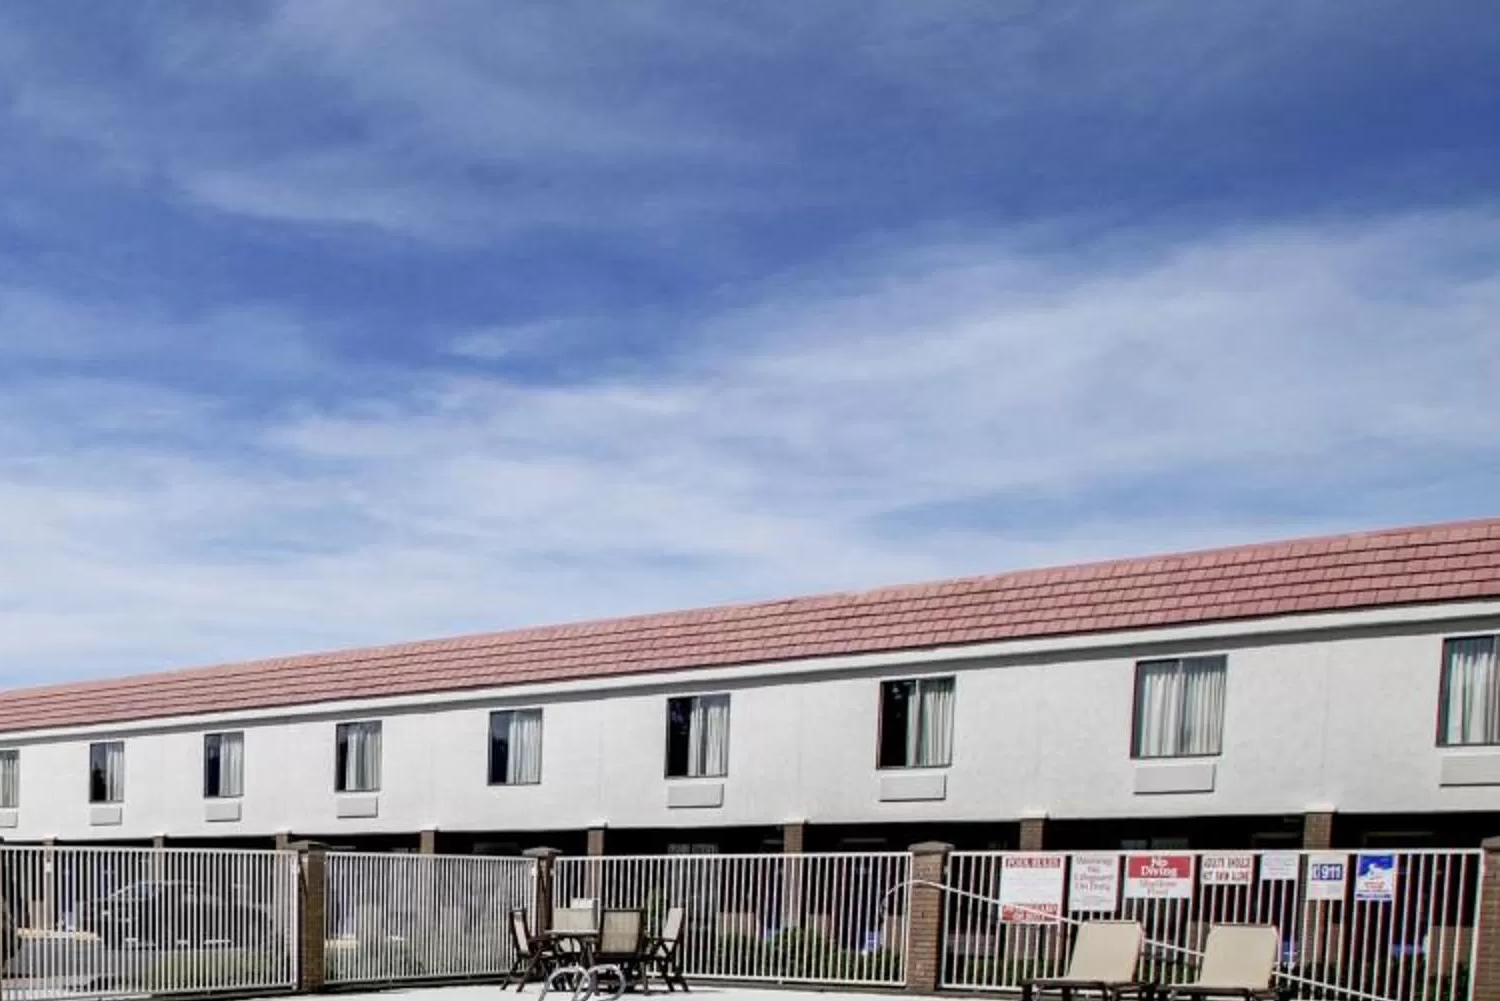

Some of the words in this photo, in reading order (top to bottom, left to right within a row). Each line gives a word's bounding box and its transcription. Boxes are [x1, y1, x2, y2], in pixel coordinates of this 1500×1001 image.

[1152, 856, 1168, 867] No
[1141, 866, 1178, 878] Diving
[1320, 864, 1343, 880] 911
